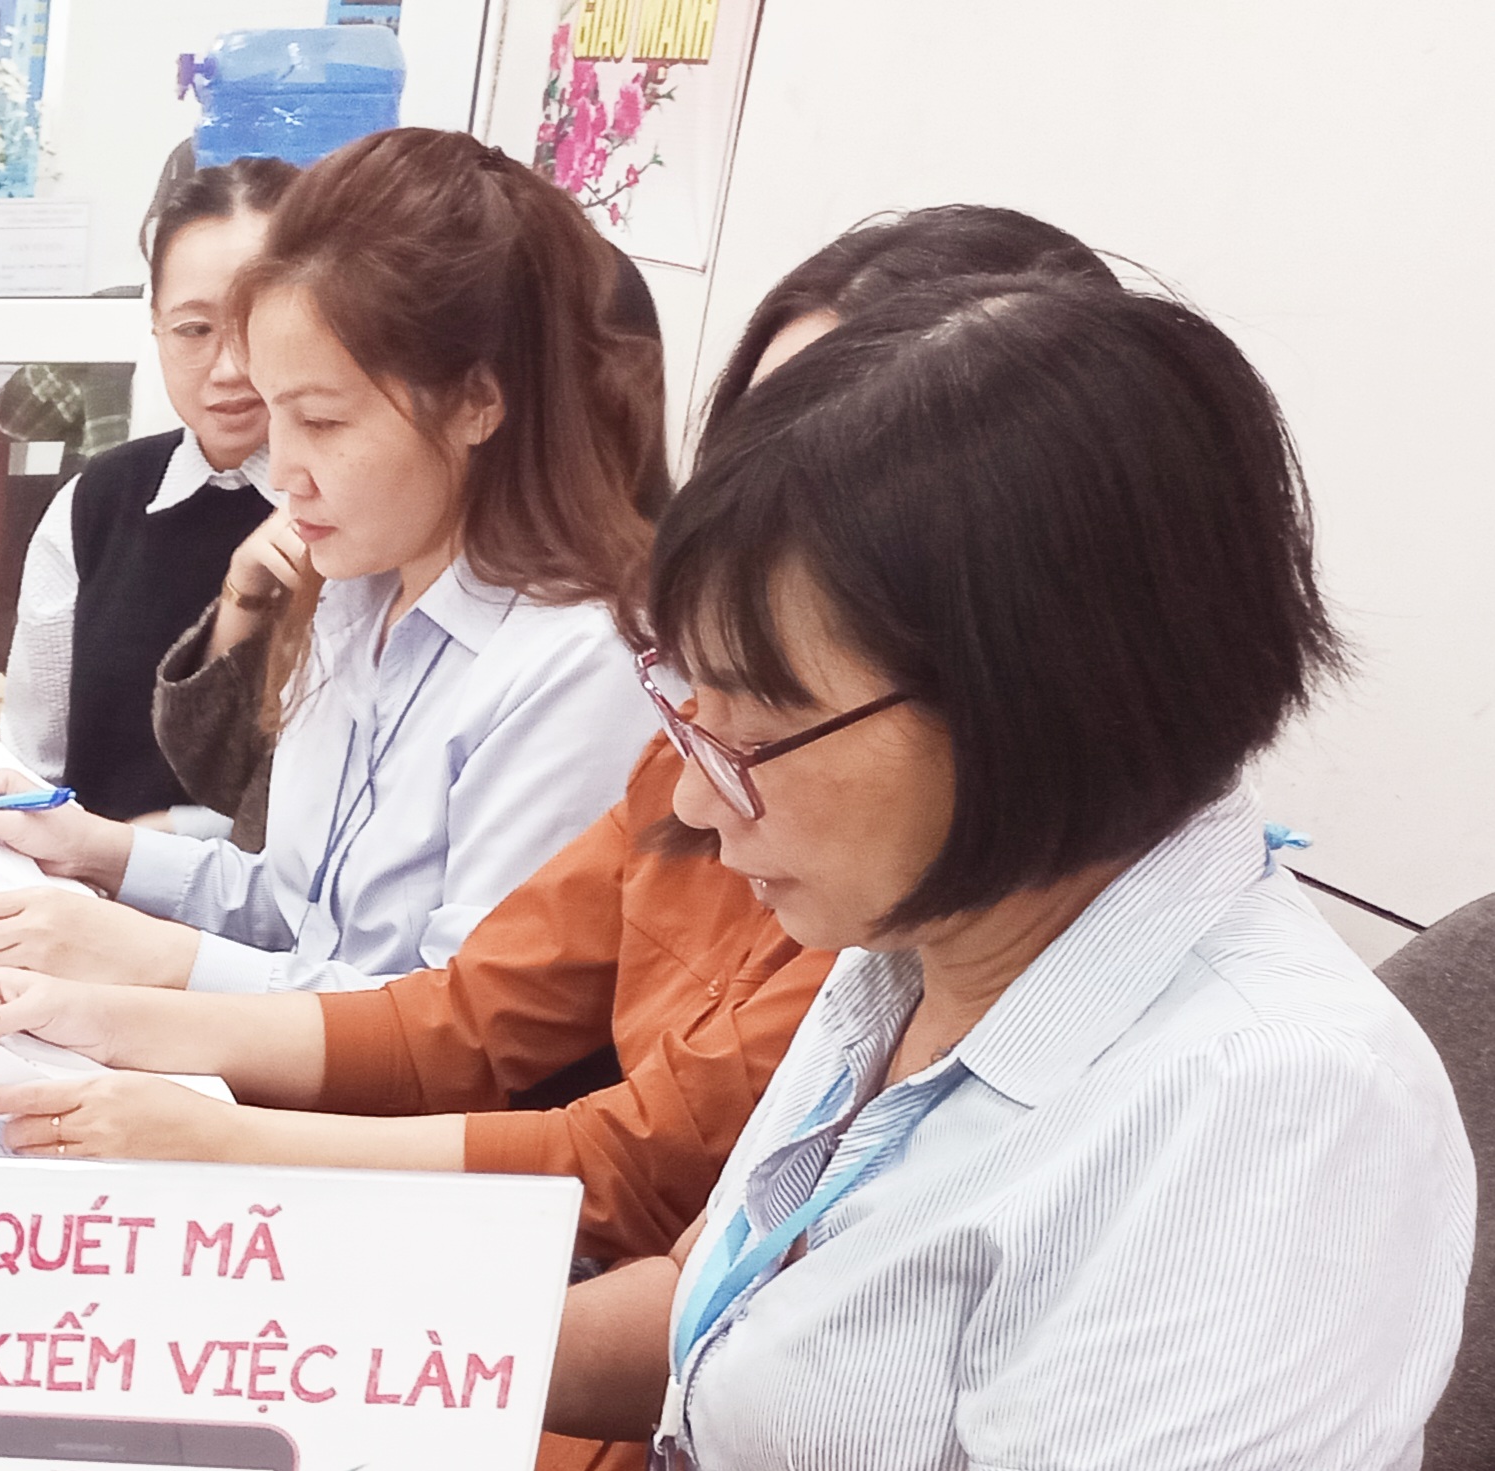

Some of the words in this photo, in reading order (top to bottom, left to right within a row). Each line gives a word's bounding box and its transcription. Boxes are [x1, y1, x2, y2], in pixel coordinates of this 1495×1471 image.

[181, 1204, 285, 1281] MÃ
[171, 1320, 337, 1413] VIỆC
[364, 1330, 515, 1410] LÀM
